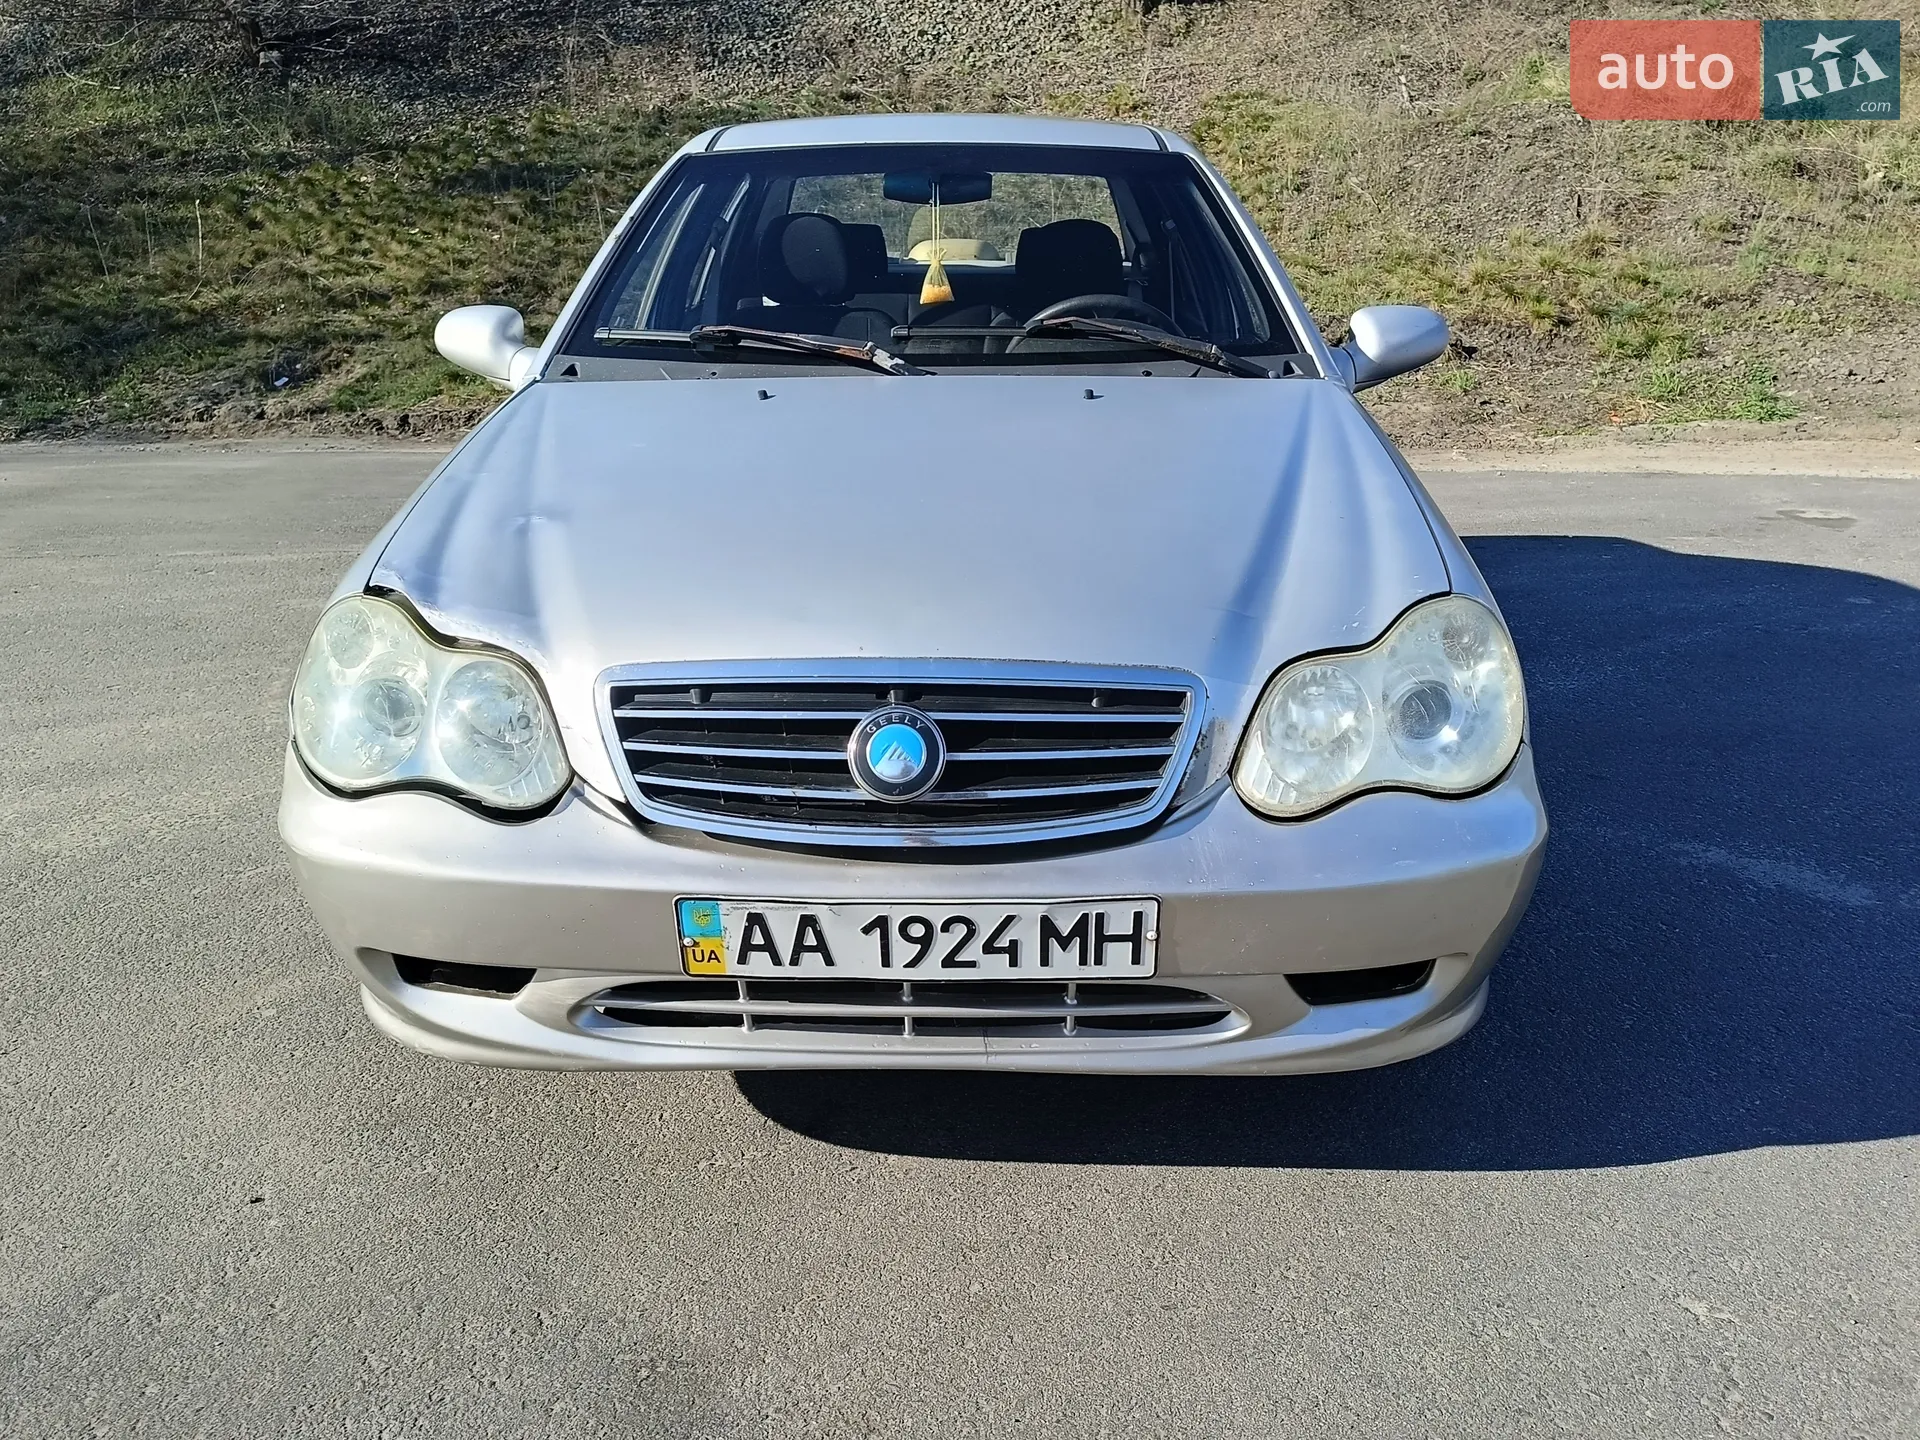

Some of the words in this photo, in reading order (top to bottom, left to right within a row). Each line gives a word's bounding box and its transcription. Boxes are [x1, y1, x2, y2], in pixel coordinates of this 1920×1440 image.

[866, 713, 925, 734] GEELY
[736, 911, 836, 967] AA
[860, 913, 1023, 969] 1924
[1038, 910, 1144, 967] MH
[692, 948, 722, 965] UA
